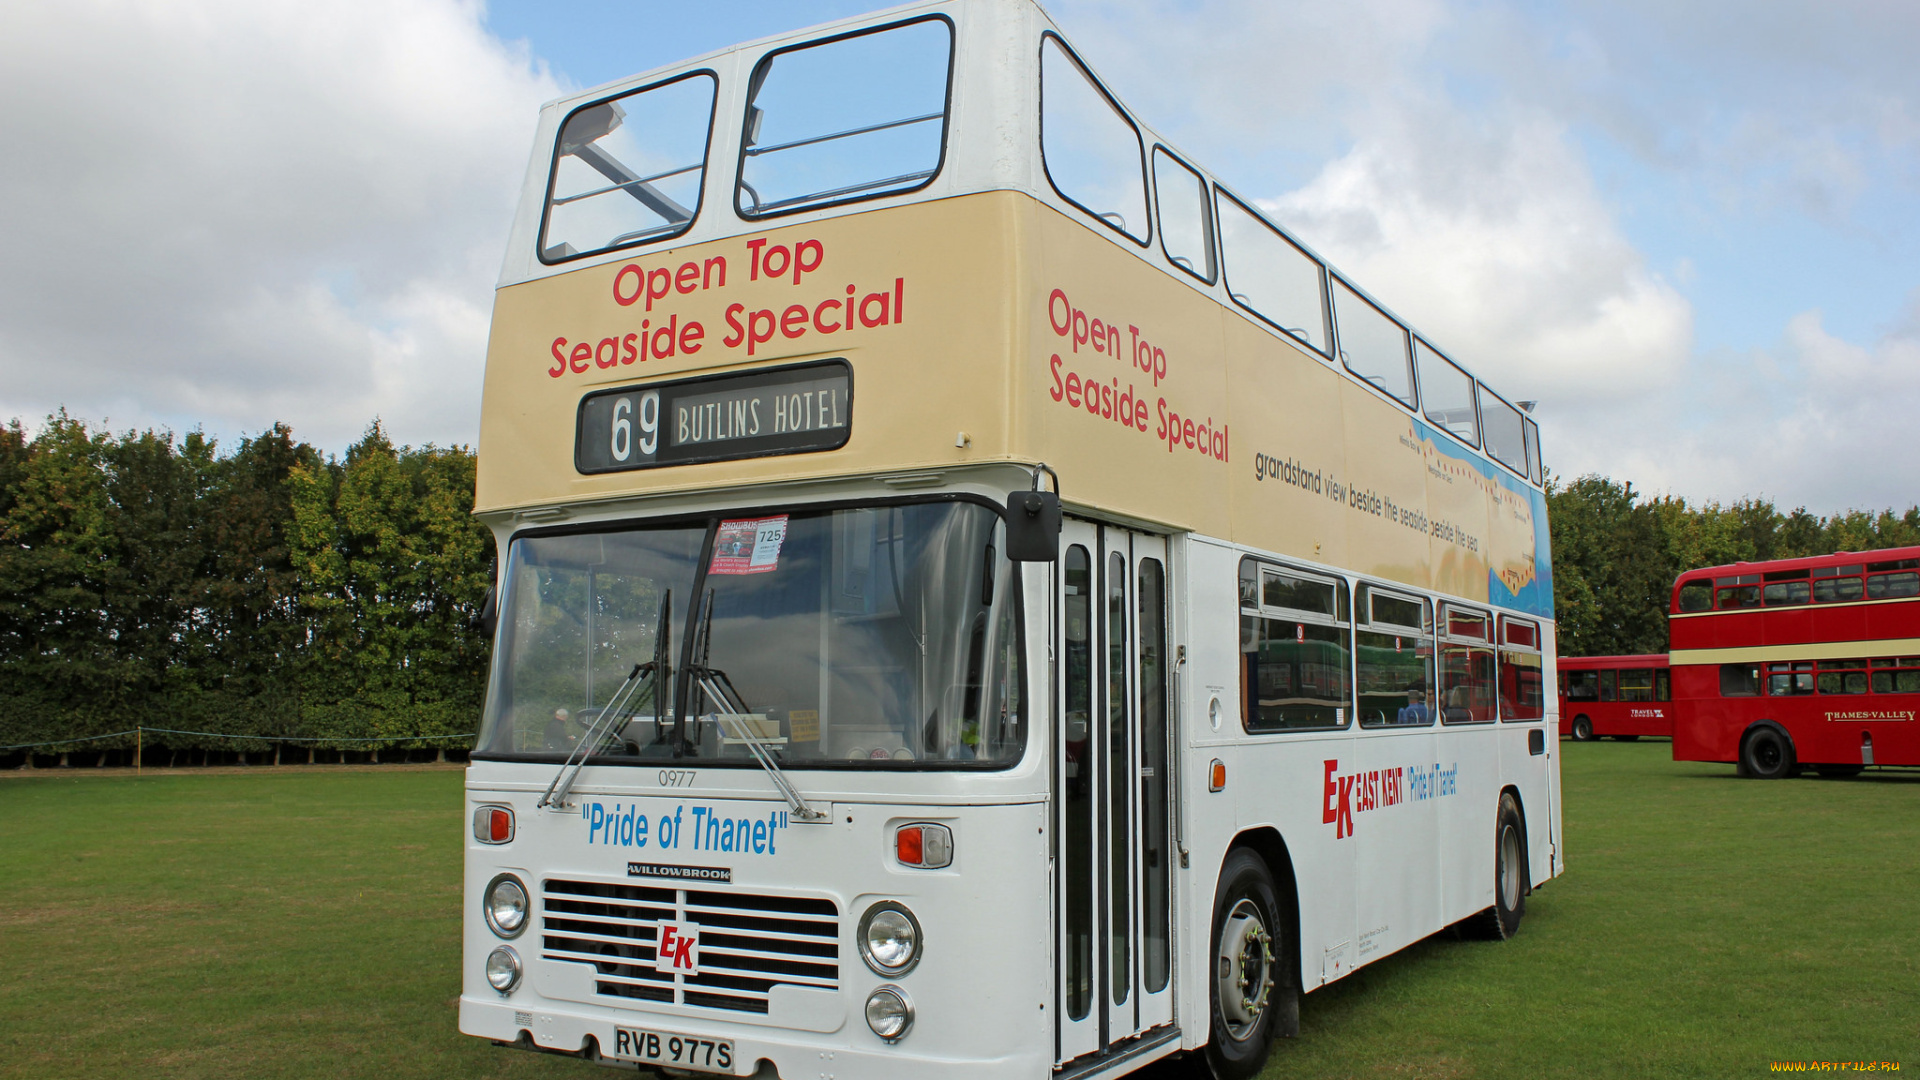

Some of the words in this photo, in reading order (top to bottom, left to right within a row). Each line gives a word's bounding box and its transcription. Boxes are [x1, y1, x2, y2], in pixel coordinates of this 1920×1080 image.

[613, 255, 726, 311] Open
[746, 237, 824, 285] Top
[548, 314, 704, 378] Seaside
[723, 277, 904, 355] Special
[1048, 288, 1121, 360] Open
[1129, 324, 1166, 387] Top
[610, 391, 660, 461] 69
[678, 400, 760, 444] BUTLINS
[774, 388, 848, 433] HOTEL
[1050, 353, 1149, 432] Seaside
[1157, 397, 1229, 463] Special
[1255, 451, 1321, 494] grandstand
[1324, 474, 1347, 504] view
[1349, 483, 1381, 516] beside
[1384, 496, 1398, 522] the
[1400, 507, 1428, 534] seaside
[1455, 524, 1467, 547] the
[1467, 534, 1479, 553] sea
[760, 530, 781, 542] 725
[658, 769, 697, 787] 0977
[1323, 759, 1355, 839] EK
[1356, 770, 1379, 812] EAST
[1381, 767, 1403, 807] KENT
[582, 802, 648, 848] "Pride
[658, 805, 683, 849] of
[692, 806, 788, 855] Thanet"
[628, 865, 731, 880] WILLOWBROOK
[660, 926, 695, 969] EK
[616, 1029, 661, 1059] RVB
[668, 1036, 732, 1069] 977S
